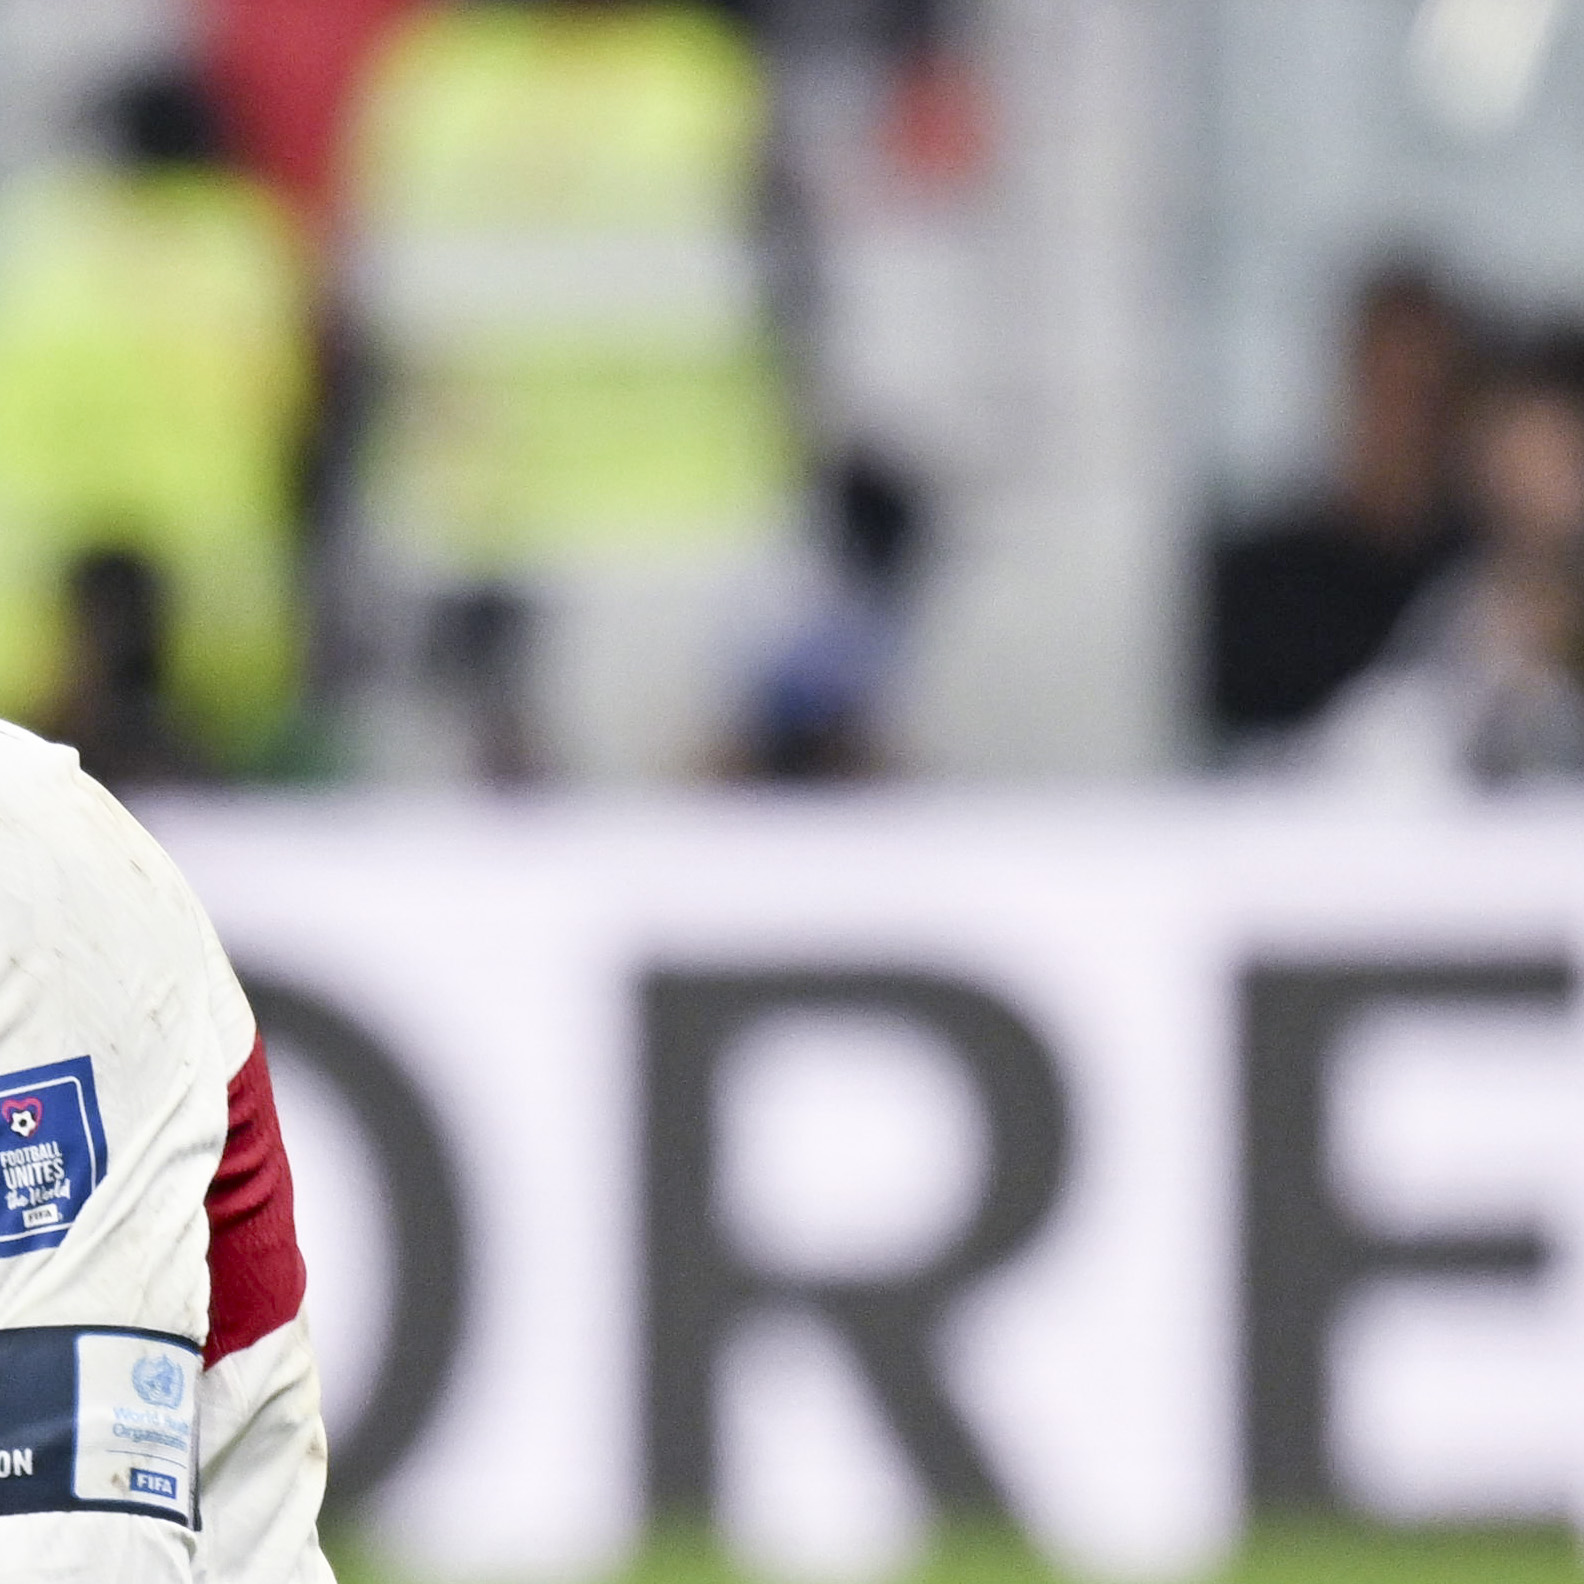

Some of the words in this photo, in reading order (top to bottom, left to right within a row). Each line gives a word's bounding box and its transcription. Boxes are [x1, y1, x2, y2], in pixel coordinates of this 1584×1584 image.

[0, 1140, 62, 1168] FOOTBALL
[3, 1157, 65, 1190] UNITES
[136, 1472, 174, 1496] FIFA
